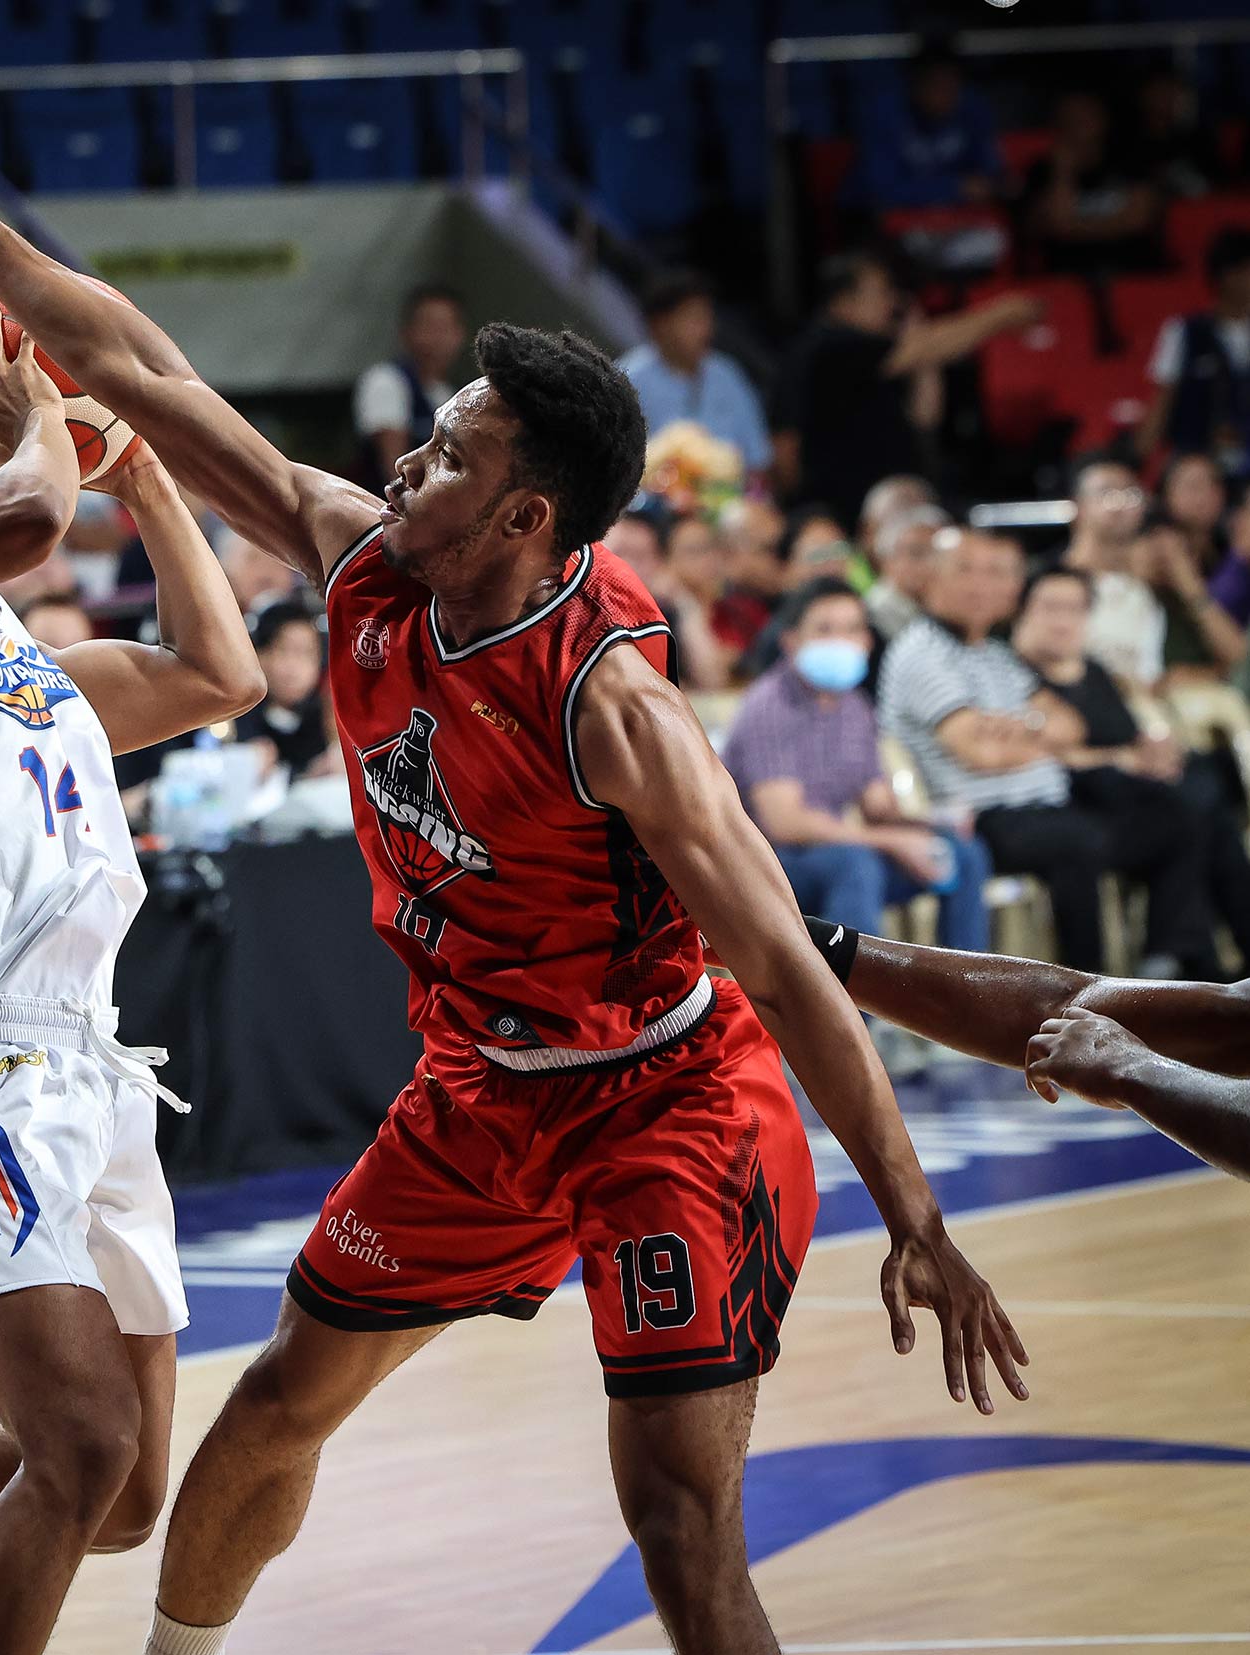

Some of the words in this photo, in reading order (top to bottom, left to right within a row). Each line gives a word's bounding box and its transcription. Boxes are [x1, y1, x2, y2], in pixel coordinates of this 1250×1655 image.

[373, 767, 446, 822] Blackwater
[325, 1216, 400, 1272] Organics
[341, 1208, 382, 1245] Ever
[613, 1232, 697, 1335] 19
